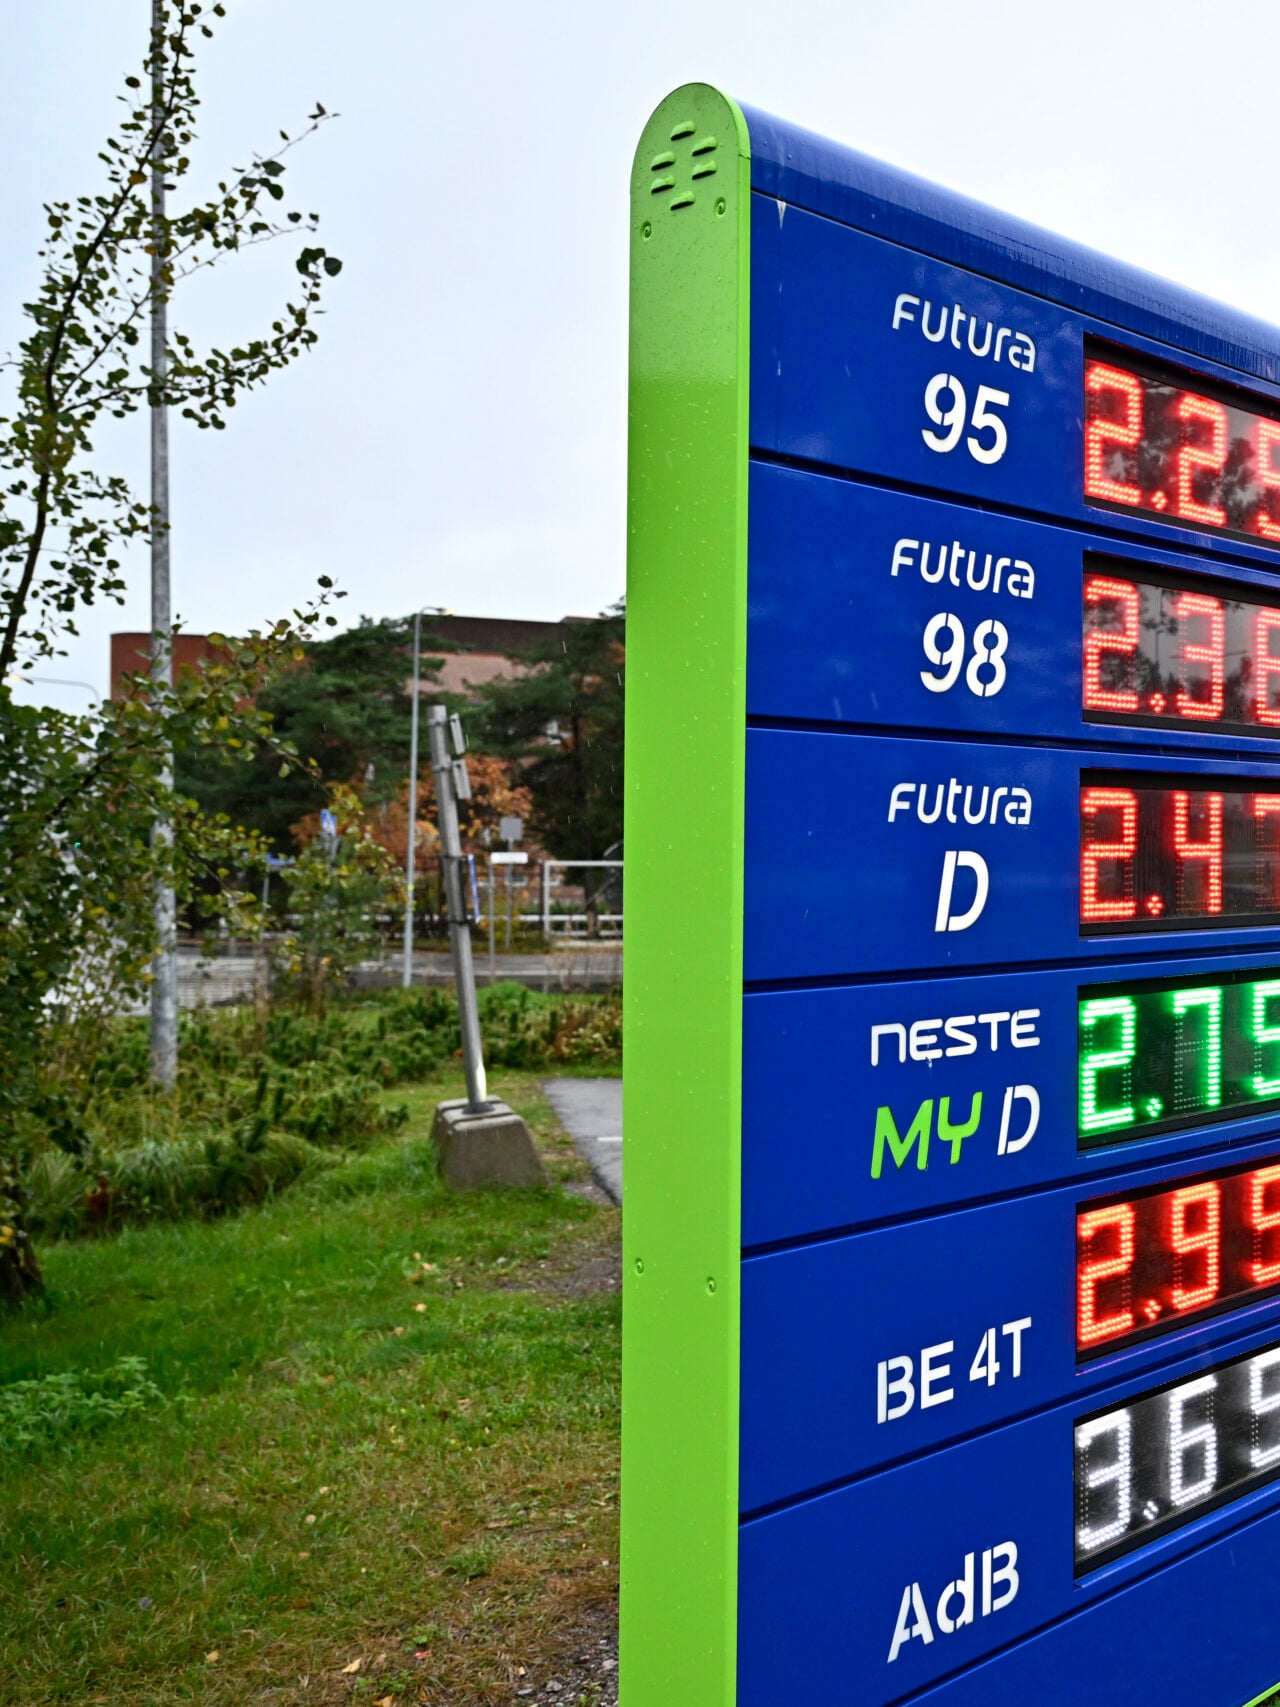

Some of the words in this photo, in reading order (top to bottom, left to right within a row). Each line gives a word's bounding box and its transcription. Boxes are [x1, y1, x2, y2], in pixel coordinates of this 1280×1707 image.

[892, 293, 1036, 373] Futura
[921, 373, 1010, 465] 95
[890, 538, 1035, 599] Futura
[920, 612, 1009, 697] 98
[887, 777, 1032, 825] Futura
[934, 850, 989, 932] D
[871, 1008, 1041, 1066] NESTE
[871, 1091, 983, 1179] MY
[997, 1084, 1040, 1156] D
[877, 1340, 954, 1424] BE
[969, 1316, 1032, 1387] 4T
[887, 1541, 1019, 1663] AdB
